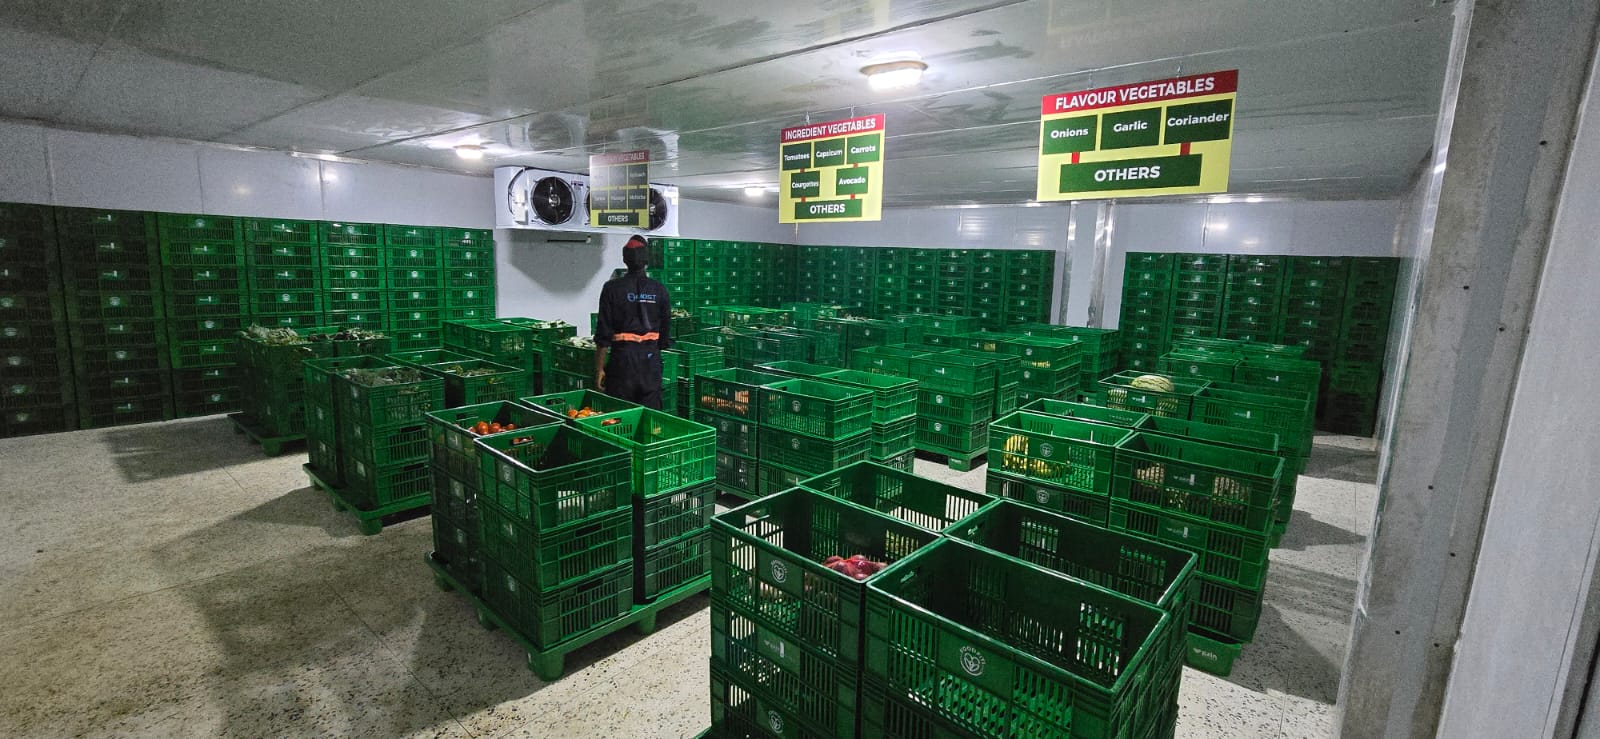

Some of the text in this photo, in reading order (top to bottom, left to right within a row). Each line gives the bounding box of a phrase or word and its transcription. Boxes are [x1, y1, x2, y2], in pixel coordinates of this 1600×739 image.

[1055, 76, 1215, 110] FLAVOUR VEGETABLES
[1167, 111, 1230, 127] Coriander
[785, 118, 876, 140] INGREDIENT VEGETABLES
[1113, 120, 1148, 133] Garlic
[1050, 127, 1089, 139] Onions
[816, 149, 843, 159] Capsicum
[850, 145, 876, 154] Carrots
[784, 153, 810, 161] Tomatoes
[1094, 165, 1161, 182] OTHERS
[838, 176, 866, 185] Avocado
[809, 204, 846, 214] OTHERS
[607, 215, 629, 223] OTHERS
